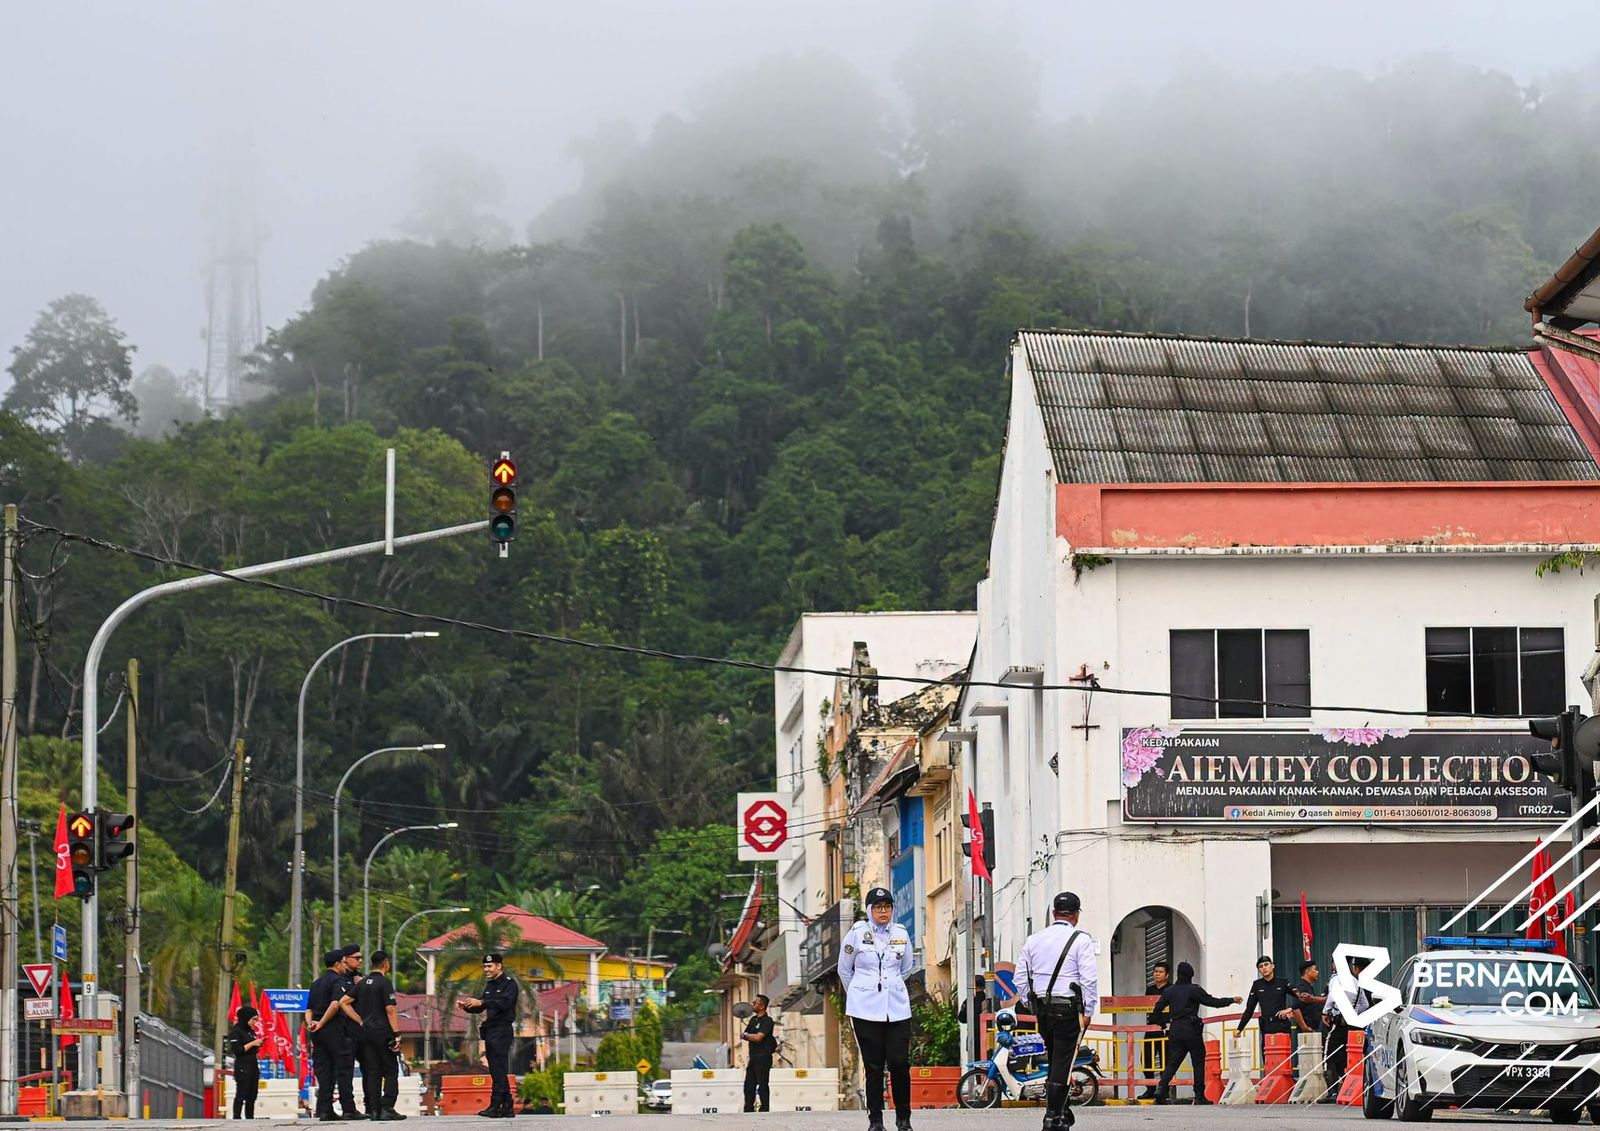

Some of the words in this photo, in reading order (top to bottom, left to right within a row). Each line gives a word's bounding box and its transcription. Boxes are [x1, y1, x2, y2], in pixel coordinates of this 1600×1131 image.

[1142, 738, 1173, 747] KEDAI
[1174, 738, 1220, 747] PAKAIAN
[1165, 755, 1320, 783] AIEMIEY
[1176, 786, 1227, 796] MENJUAL
[1229, 786, 1277, 796] PAKAIAN
[1279, 786, 1364, 797] KANAK-KANAK,
[1366, 786, 1411, 796] DEWASA
[1414, 786, 1437, 796] DAN
[1440, 786, 1491, 796] PELBAGAI
[1494, 786, 1547, 796] AKSESORI
[1242, 809, 1266, 817] Kedai
[1267, 809, 1296, 818] Aimiey
[1308, 809, 1333, 818] qaseh
[1335, 809, 1362, 818] aimiey
[1373, 809, 1492, 817] 011-64130601/012-8063098
[1518, 805, 1566, 815] (TR027
[86, 983, 91, 993] 9
[1505, 1066, 1523, 1077] VPX
